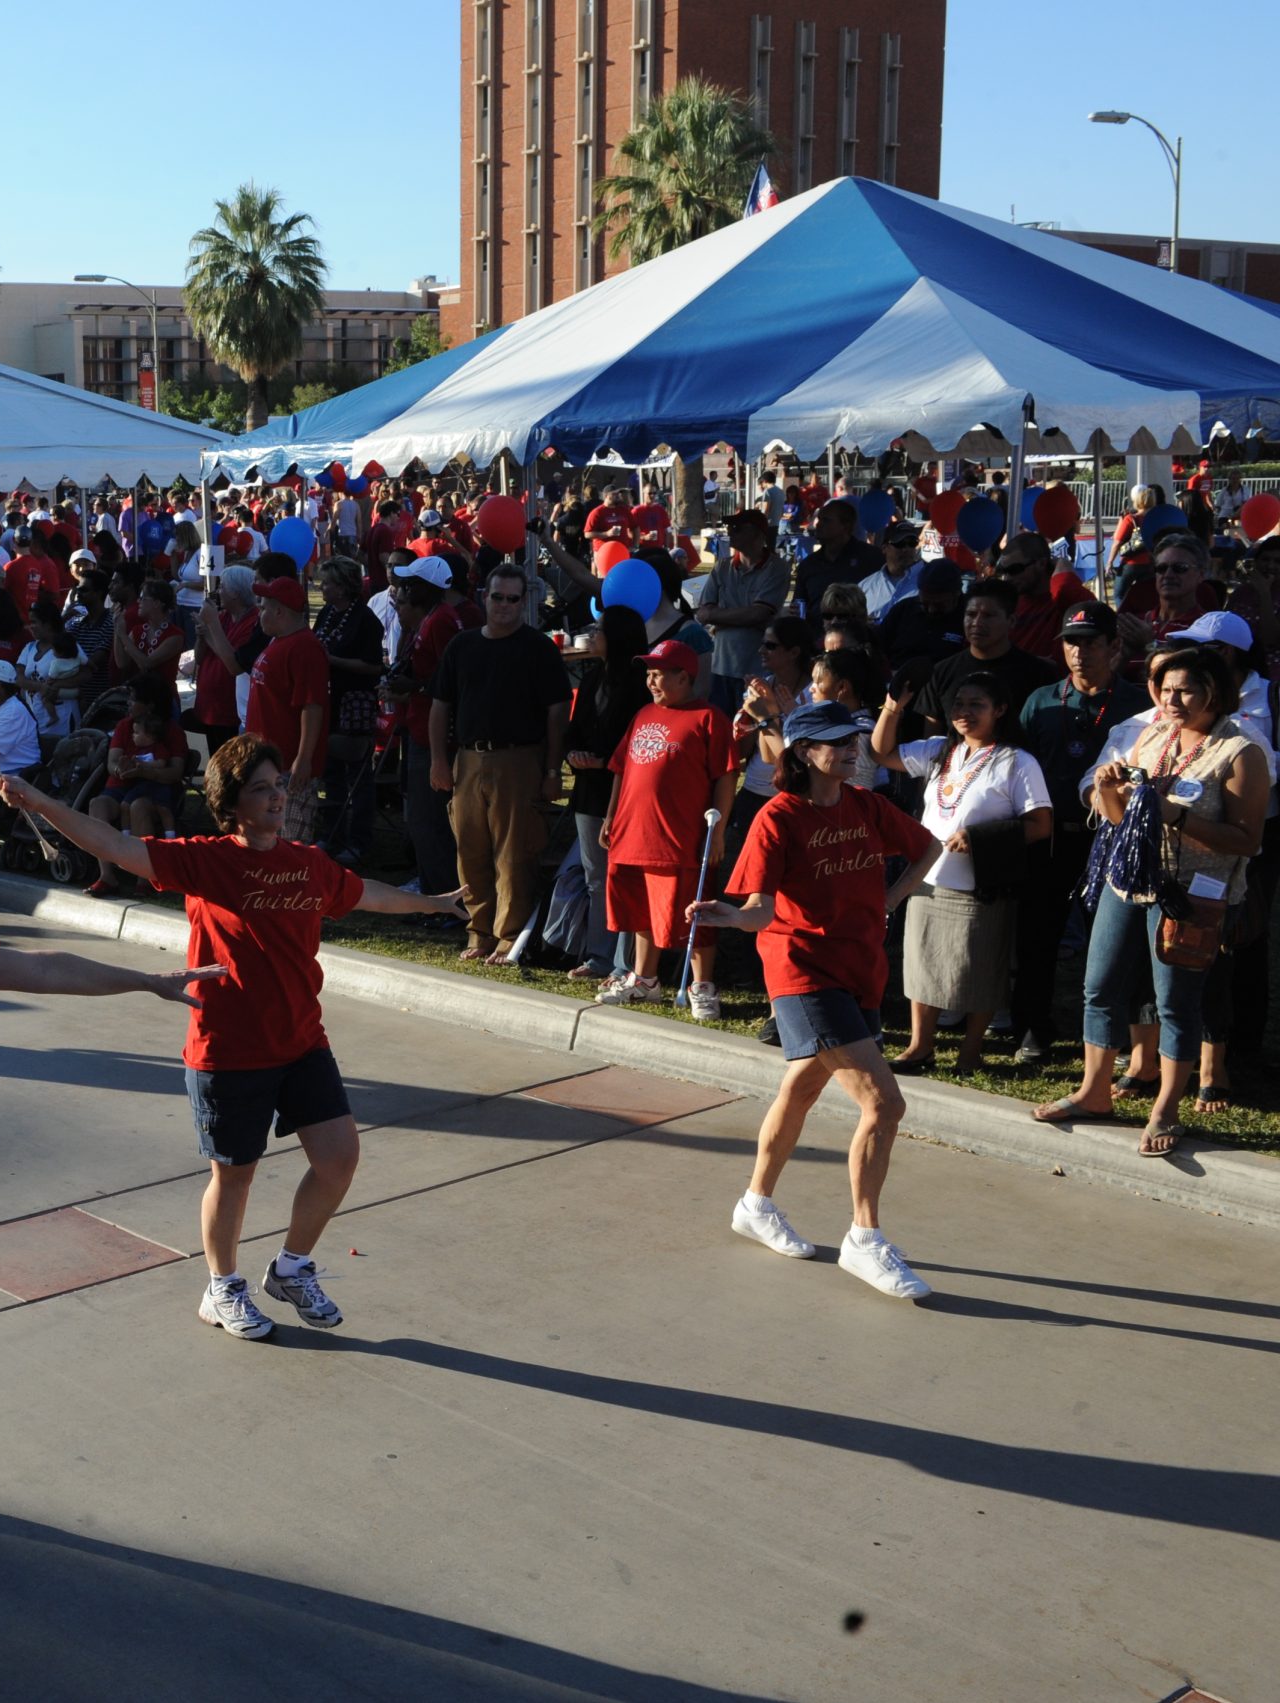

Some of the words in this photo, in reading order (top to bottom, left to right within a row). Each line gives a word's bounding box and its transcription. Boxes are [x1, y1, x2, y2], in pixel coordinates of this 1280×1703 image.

[635, 722, 671, 738] ARIZONA
[807, 823, 869, 848] Alumni
[813, 849, 885, 880] Twirler
[241, 890, 323, 911] Twirler
